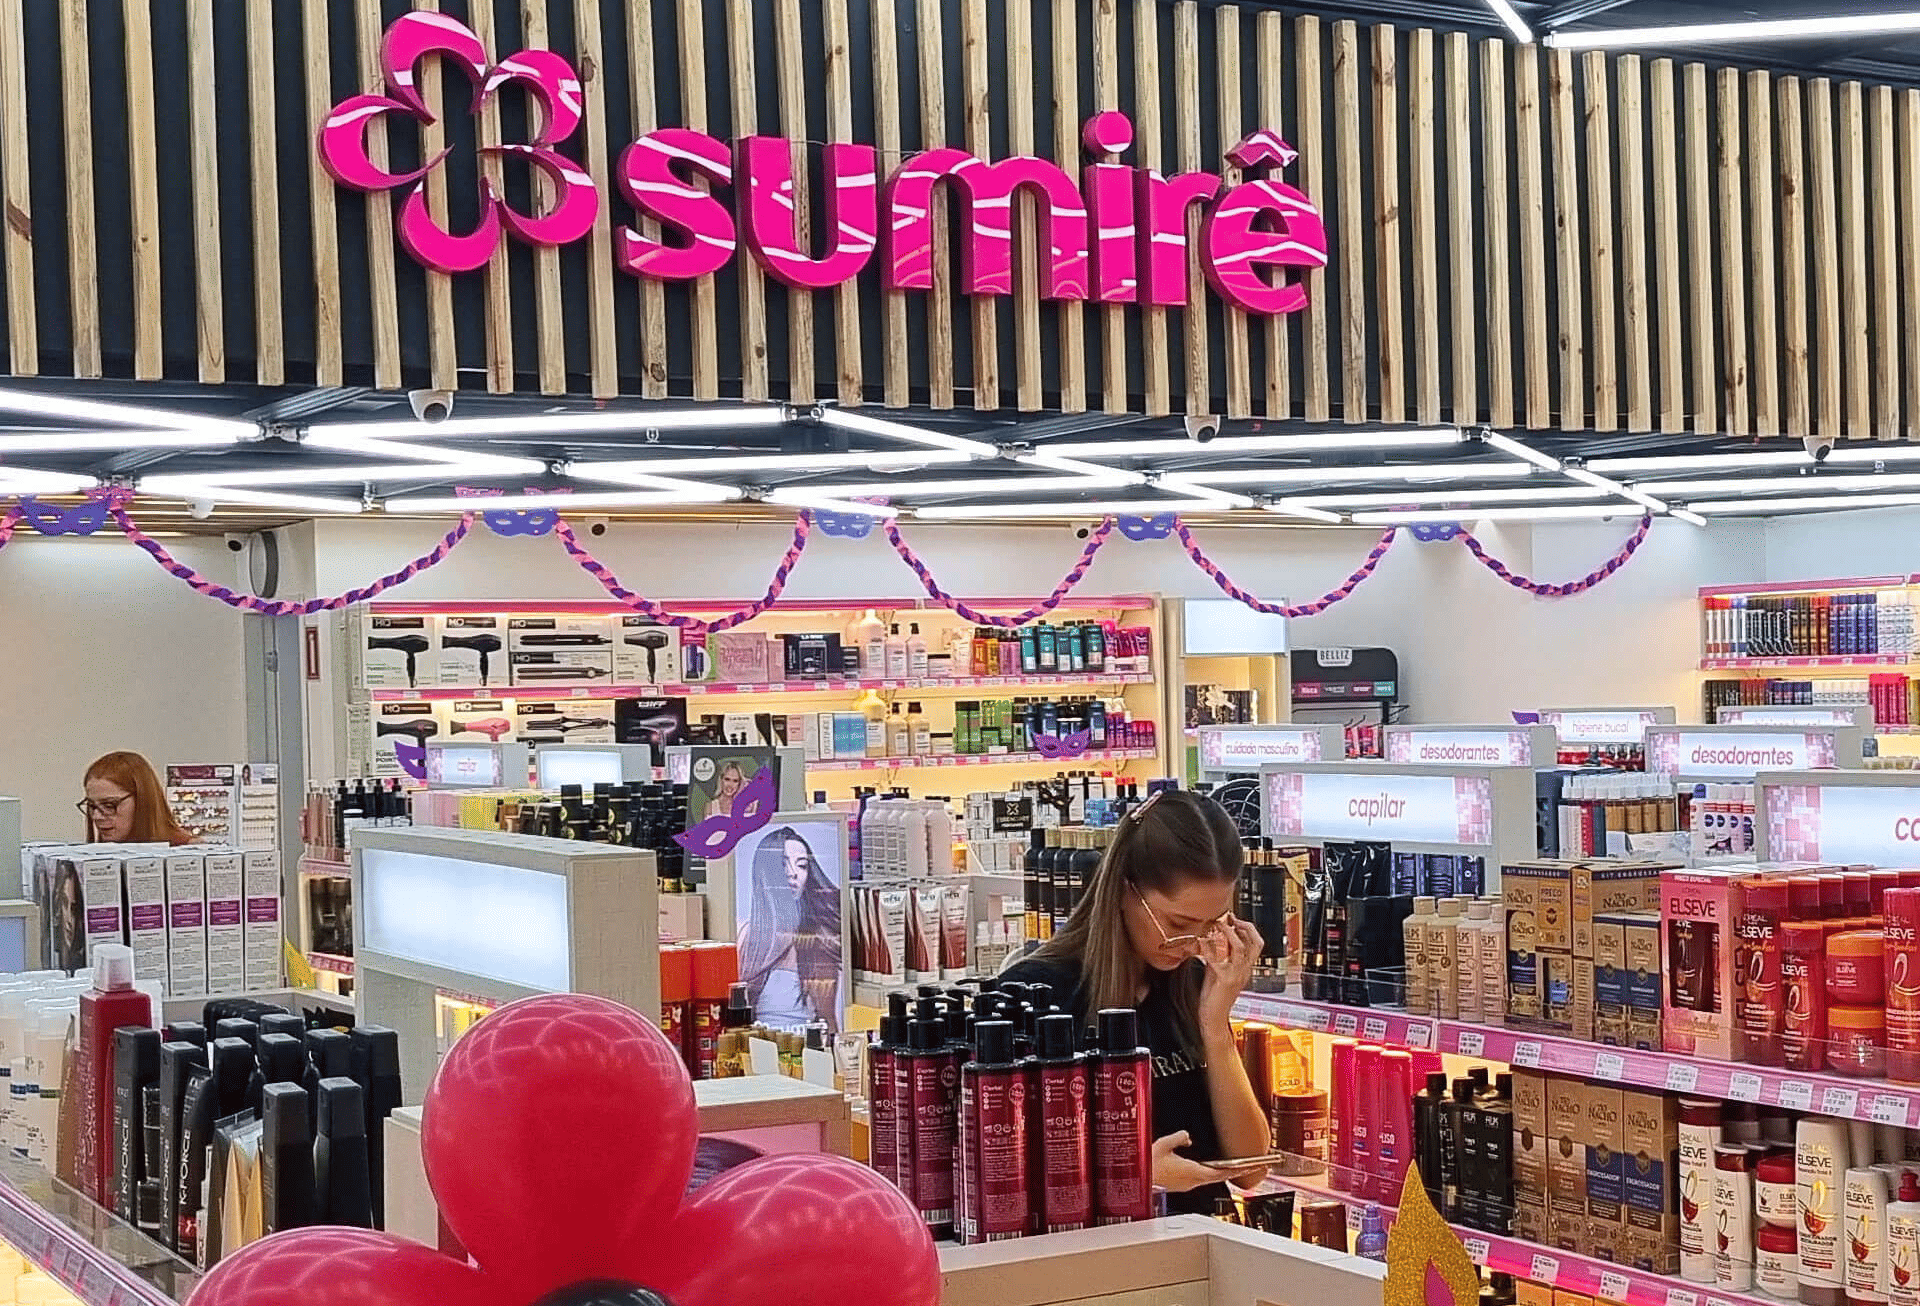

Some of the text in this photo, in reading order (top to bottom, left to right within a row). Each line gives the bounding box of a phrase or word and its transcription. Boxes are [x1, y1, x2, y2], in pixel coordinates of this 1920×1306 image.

[617, 110, 1328, 315] sumirê
[1320, 650, 1350, 660] BELLIZ
[1571, 719, 1602, 737] higiene
[1420, 743, 1500, 761] desodorantes
[1691, 745, 1794, 766] desodorantes
[1348, 792, 1406, 826] capilar
[1670, 897, 1716, 917] ELSEVE
[1781, 963, 1809, 977] LSEVE
[1680, 1147, 1707, 1160] LSEVE
[1798, 1154, 1832, 1169] ELSEVE
[179, 1129, 191, 1205] K-FORCE
